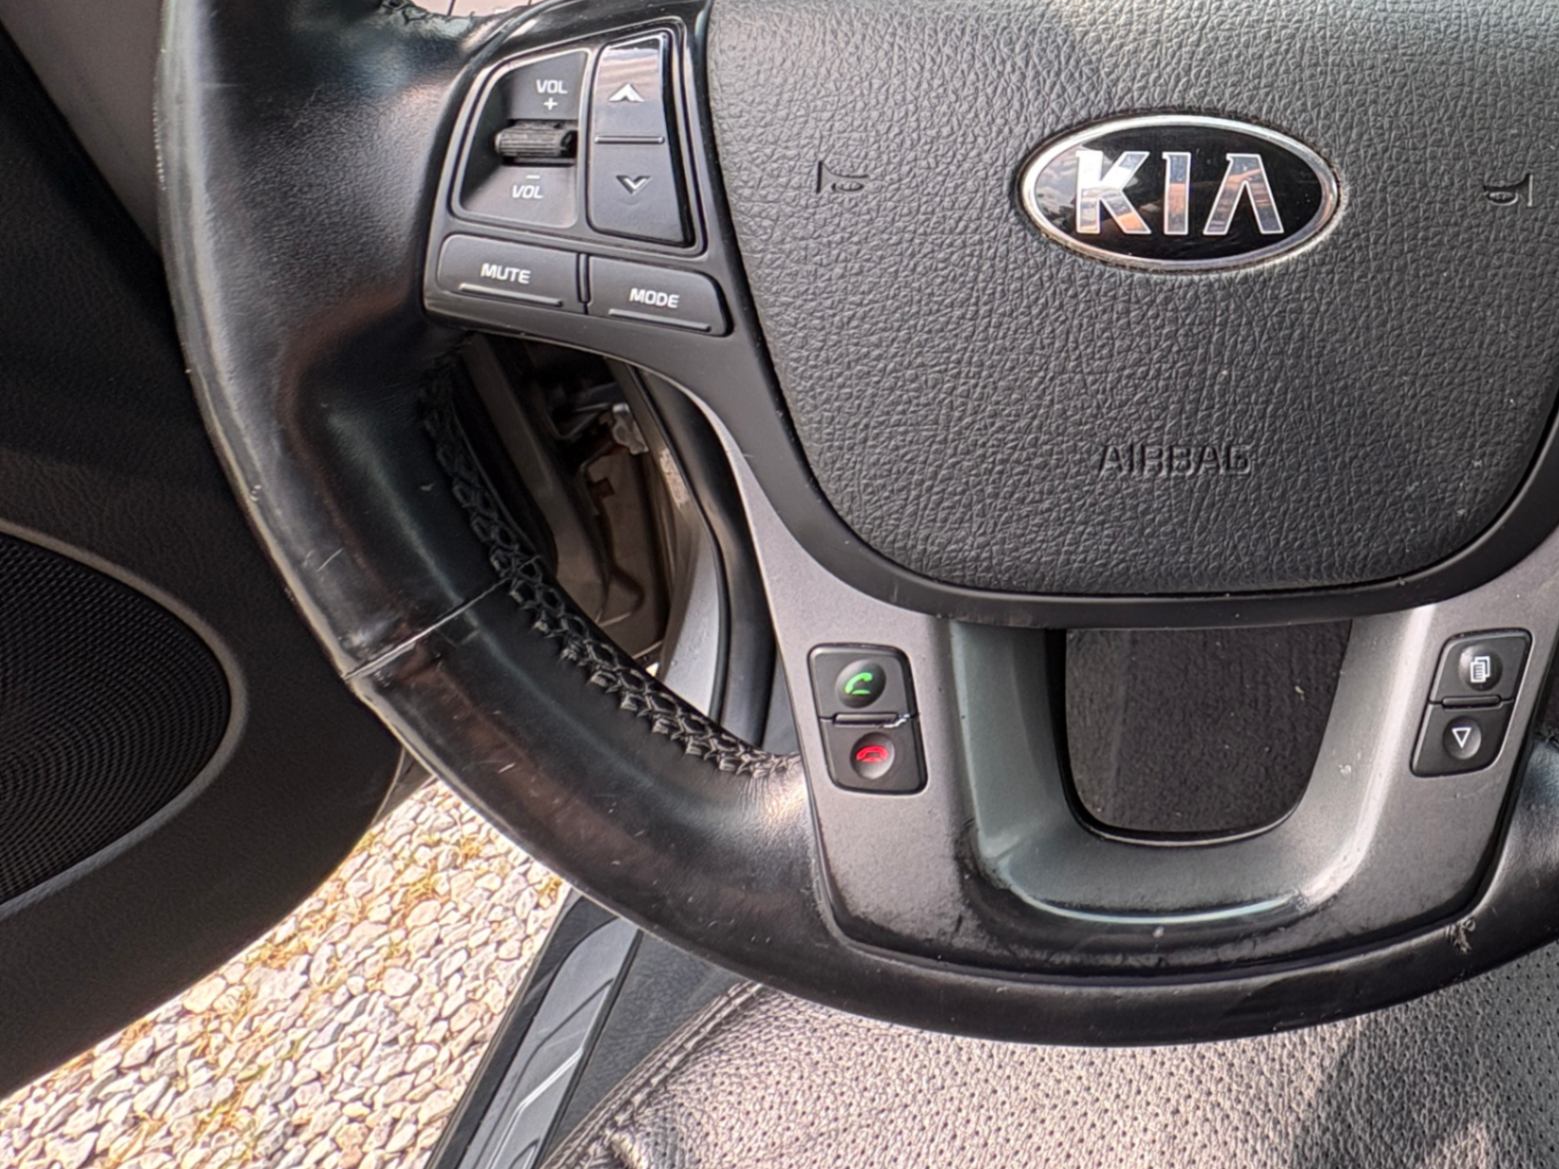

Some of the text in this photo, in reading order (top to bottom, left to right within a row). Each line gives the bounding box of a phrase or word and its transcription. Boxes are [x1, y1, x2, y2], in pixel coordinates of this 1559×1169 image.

[536, 79, 568, 95] VOL
[511, 185, 545, 199] VOL
[1075, 150, 1285, 236] KIA
[481, 263, 531, 284] MUTE
[629, 288, 680, 309] MODE
[1101, 443, 1252, 476] AIRBAG
